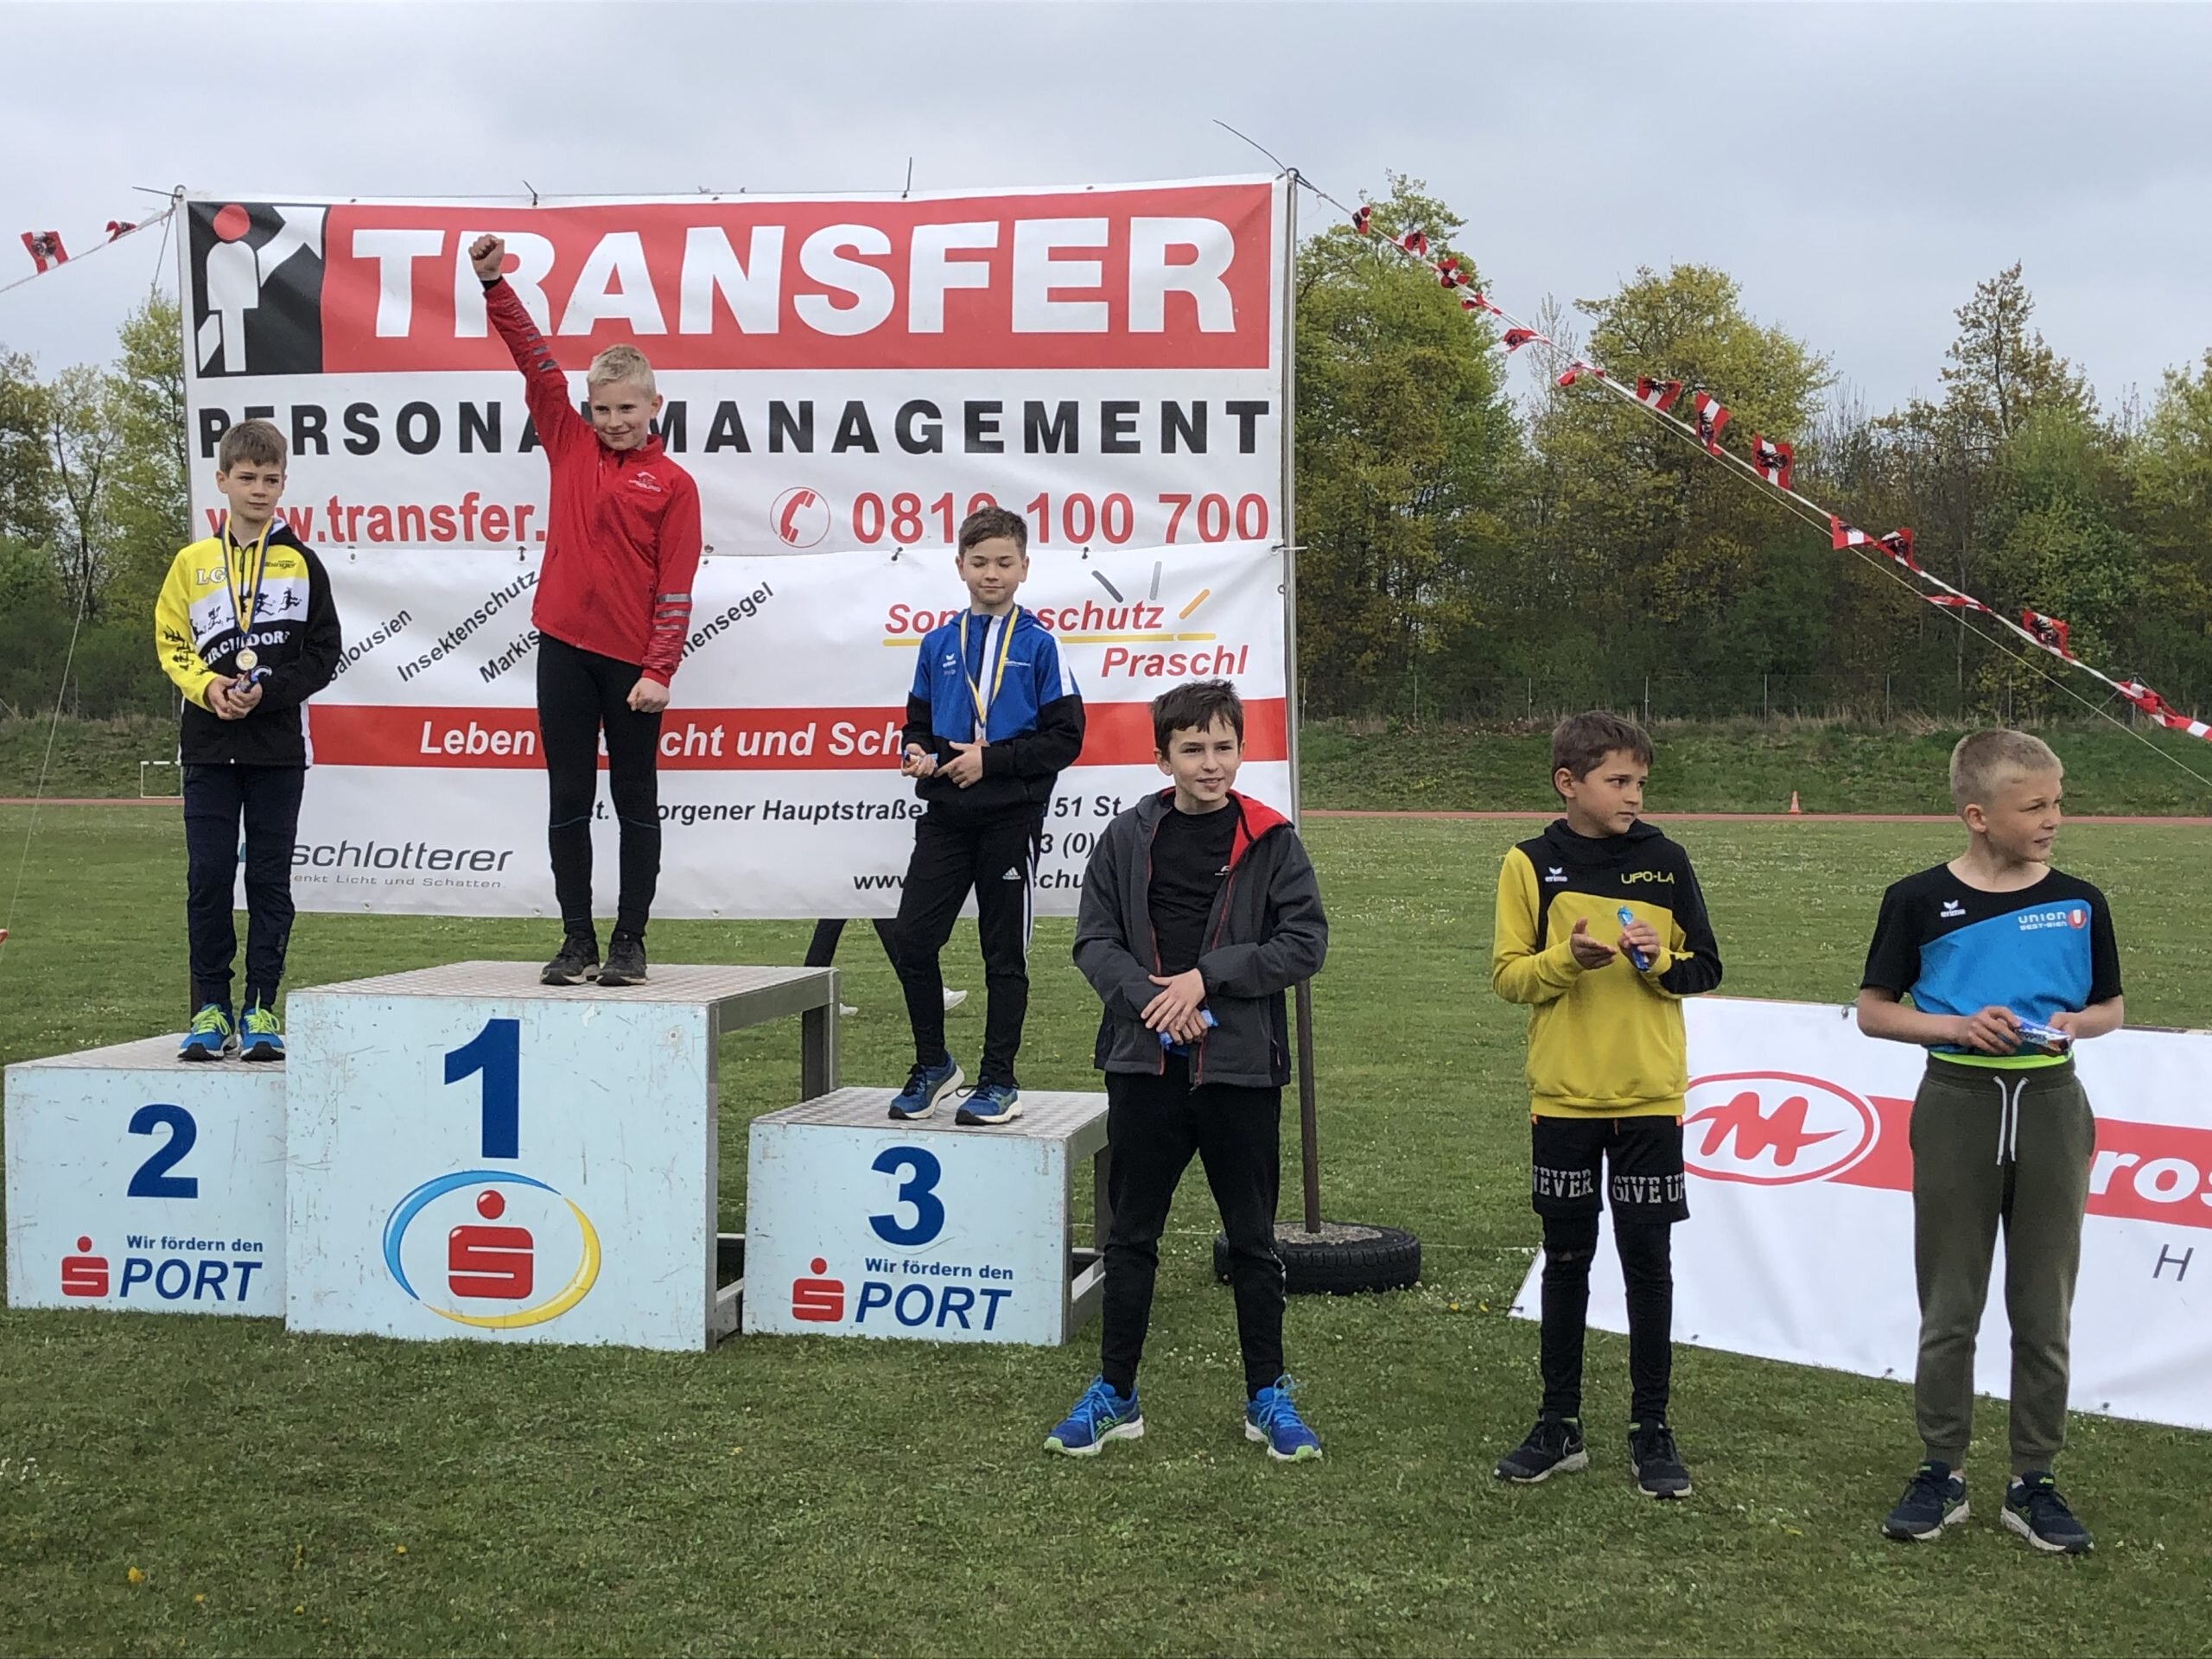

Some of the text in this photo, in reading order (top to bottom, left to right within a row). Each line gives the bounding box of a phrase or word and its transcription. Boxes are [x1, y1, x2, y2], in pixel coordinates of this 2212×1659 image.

[353, 216, 1236, 338] TRANSFER
[1027, 492, 1133, 544] 100
[1159, 493, 1269, 543] 700
[397, 571, 539, 683] Insektenschutz
[885, 600, 1164, 634] Sonschutz
[479, 628, 541, 683] Markis
[1101, 645, 1249, 678] Praschl
[420, 721, 536, 756] Leben
[659, 722, 725, 757] cht
[736, 722, 817, 757] und
[658, 804, 755, 826] orgener
[763, 798, 923, 826] Hauptstraße
[290, 839, 513, 872] schlotterer
[291, 874, 329, 884] enkt
[336, 874, 377, 885] Licht
[385, 876, 415, 886] und
[1621, 871, 1675, 885] UPO-LA
[444, 1019, 520, 1159] 1
[127, 1103, 199, 1198] 2
[868, 1145, 945, 1246] 3
[1612, 1175, 1662, 1204] GIVE
[127, 1236, 264, 1253] Wir fördern den
[865, 1257, 1014, 1281] Wir fördern den
